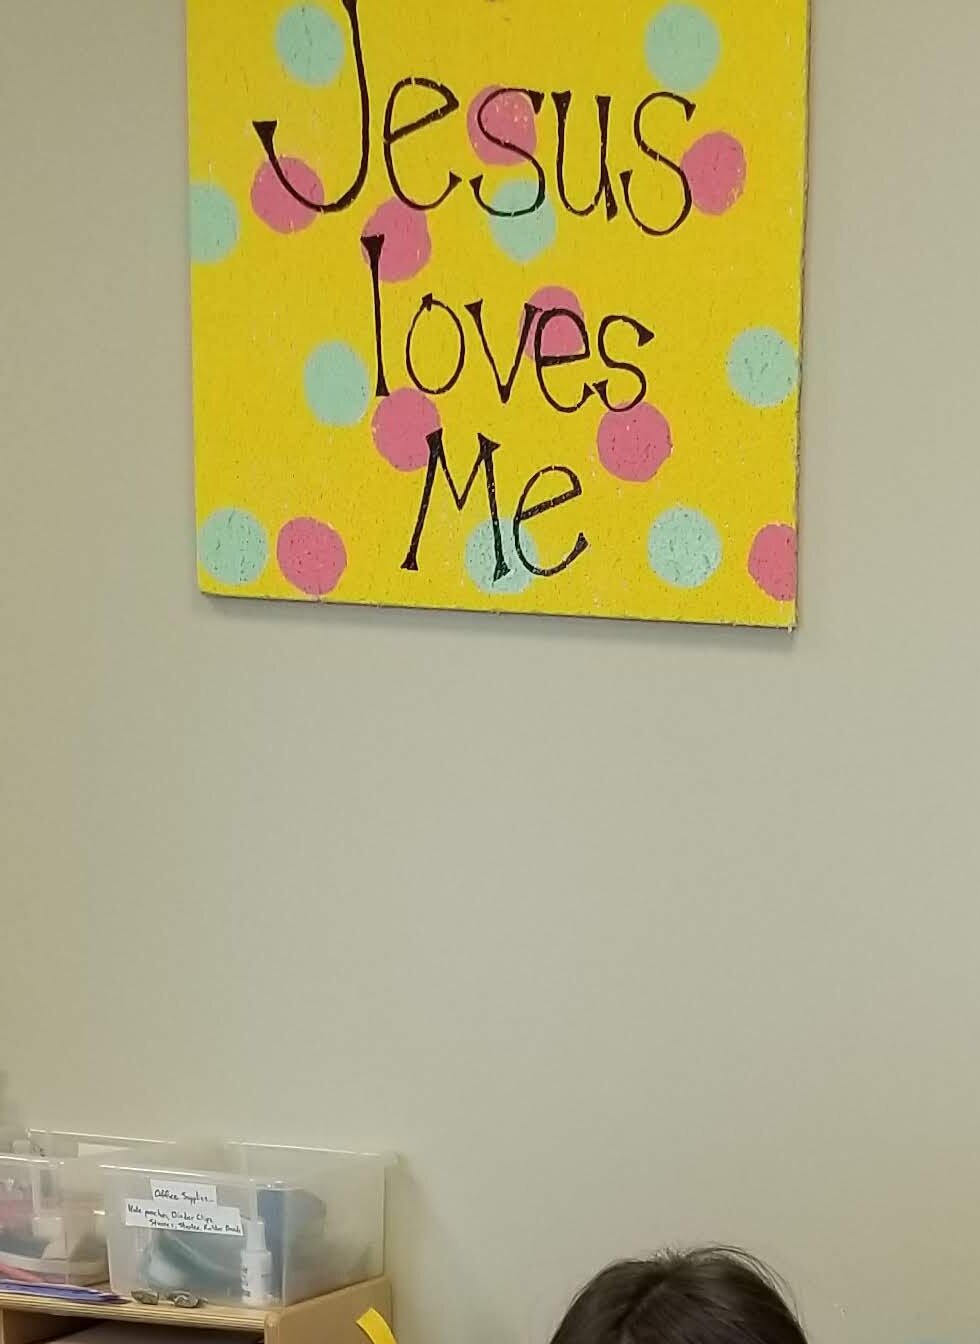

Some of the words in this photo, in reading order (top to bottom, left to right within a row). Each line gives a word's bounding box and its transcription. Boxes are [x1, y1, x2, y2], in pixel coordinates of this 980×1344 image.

[252, 0, 696, 236] Jesus
[360, 234, 654, 413] loves
[400, 428, 589, 581] Me
[154, 1189, 179, 1201] Office
